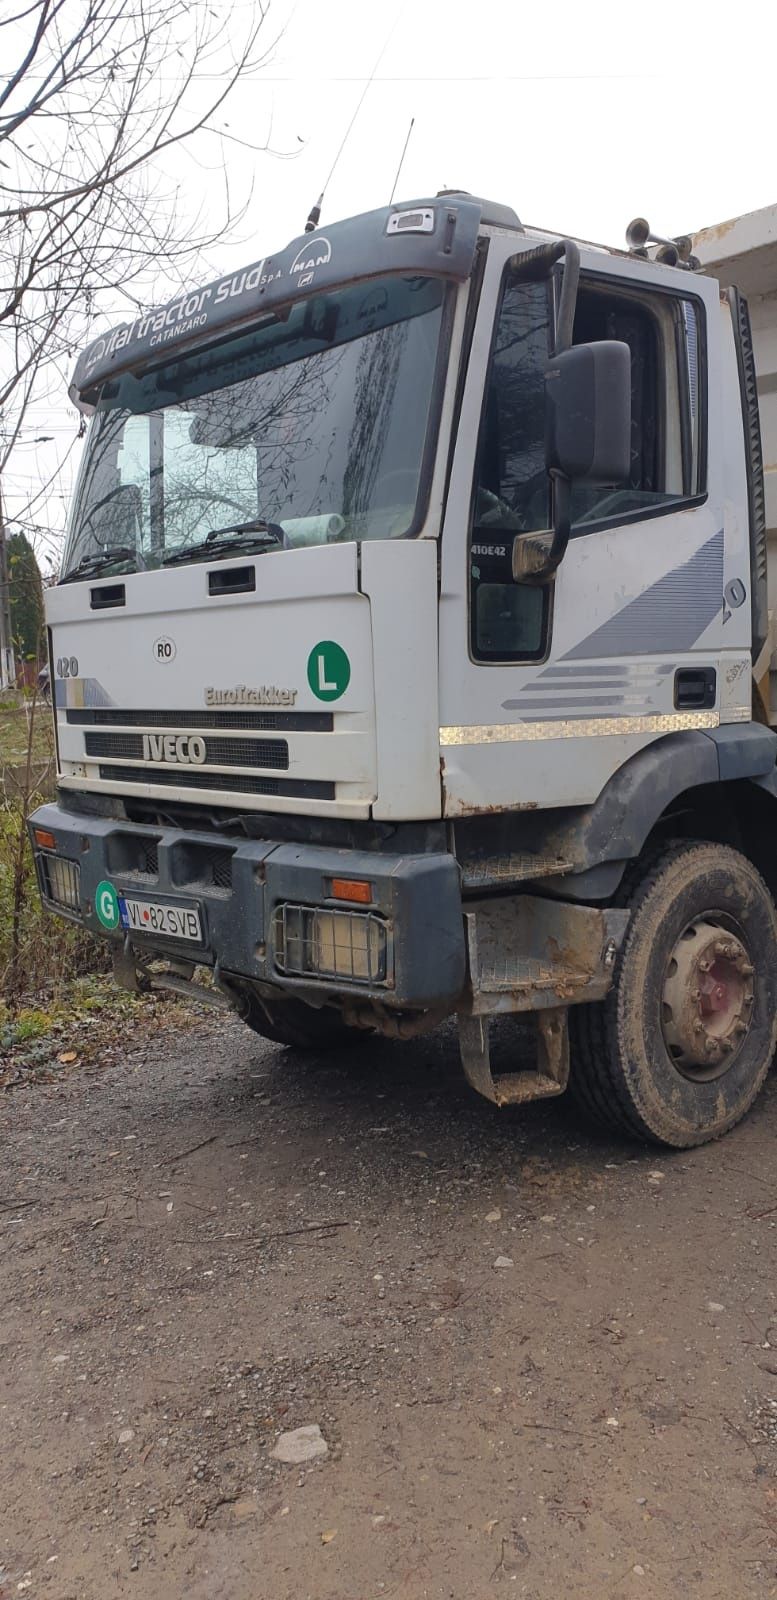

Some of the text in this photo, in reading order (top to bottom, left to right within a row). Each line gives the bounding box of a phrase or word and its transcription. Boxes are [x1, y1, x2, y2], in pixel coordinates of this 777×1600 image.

[293, 255, 329, 273] MAN
[105, 320, 136, 356] ital
[137, 289, 212, 339] tractor
[214, 259, 266, 304] sud
[149, 312, 208, 346] CATANZARO
[470, 544, 506, 556] 410E42
[157, 643, 172, 658] RO
[56, 656, 79, 678] 420
[317, 655, 337, 691] L
[204, 685, 298, 706] EuroTrakker
[142, 735, 206, 764] IVECO
[100, 891, 115, 921] G
